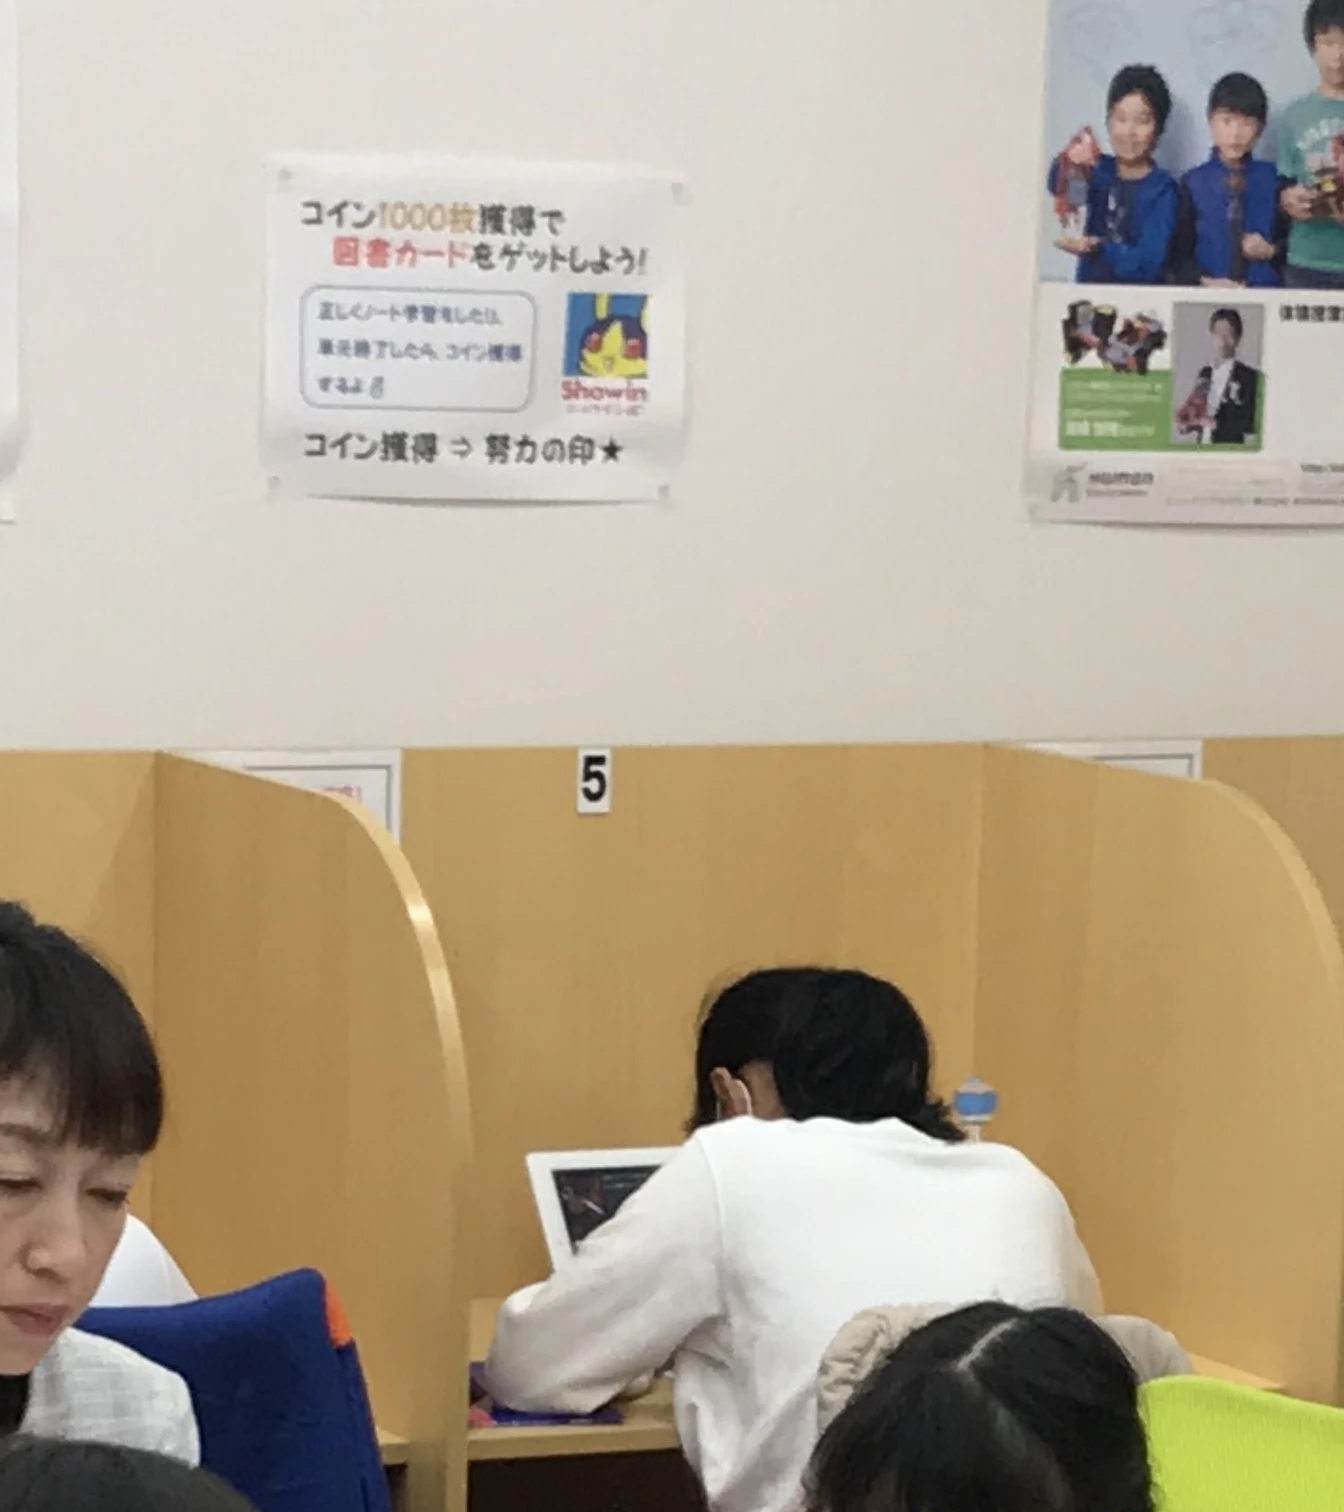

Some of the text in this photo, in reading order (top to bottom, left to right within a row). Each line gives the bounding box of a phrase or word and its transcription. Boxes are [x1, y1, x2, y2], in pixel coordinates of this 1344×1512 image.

[300, 200, 566, 236] コイン1000枚獲得で
[561, 380, 648, 403] Showin
[581, 755, 607, 803] 5
